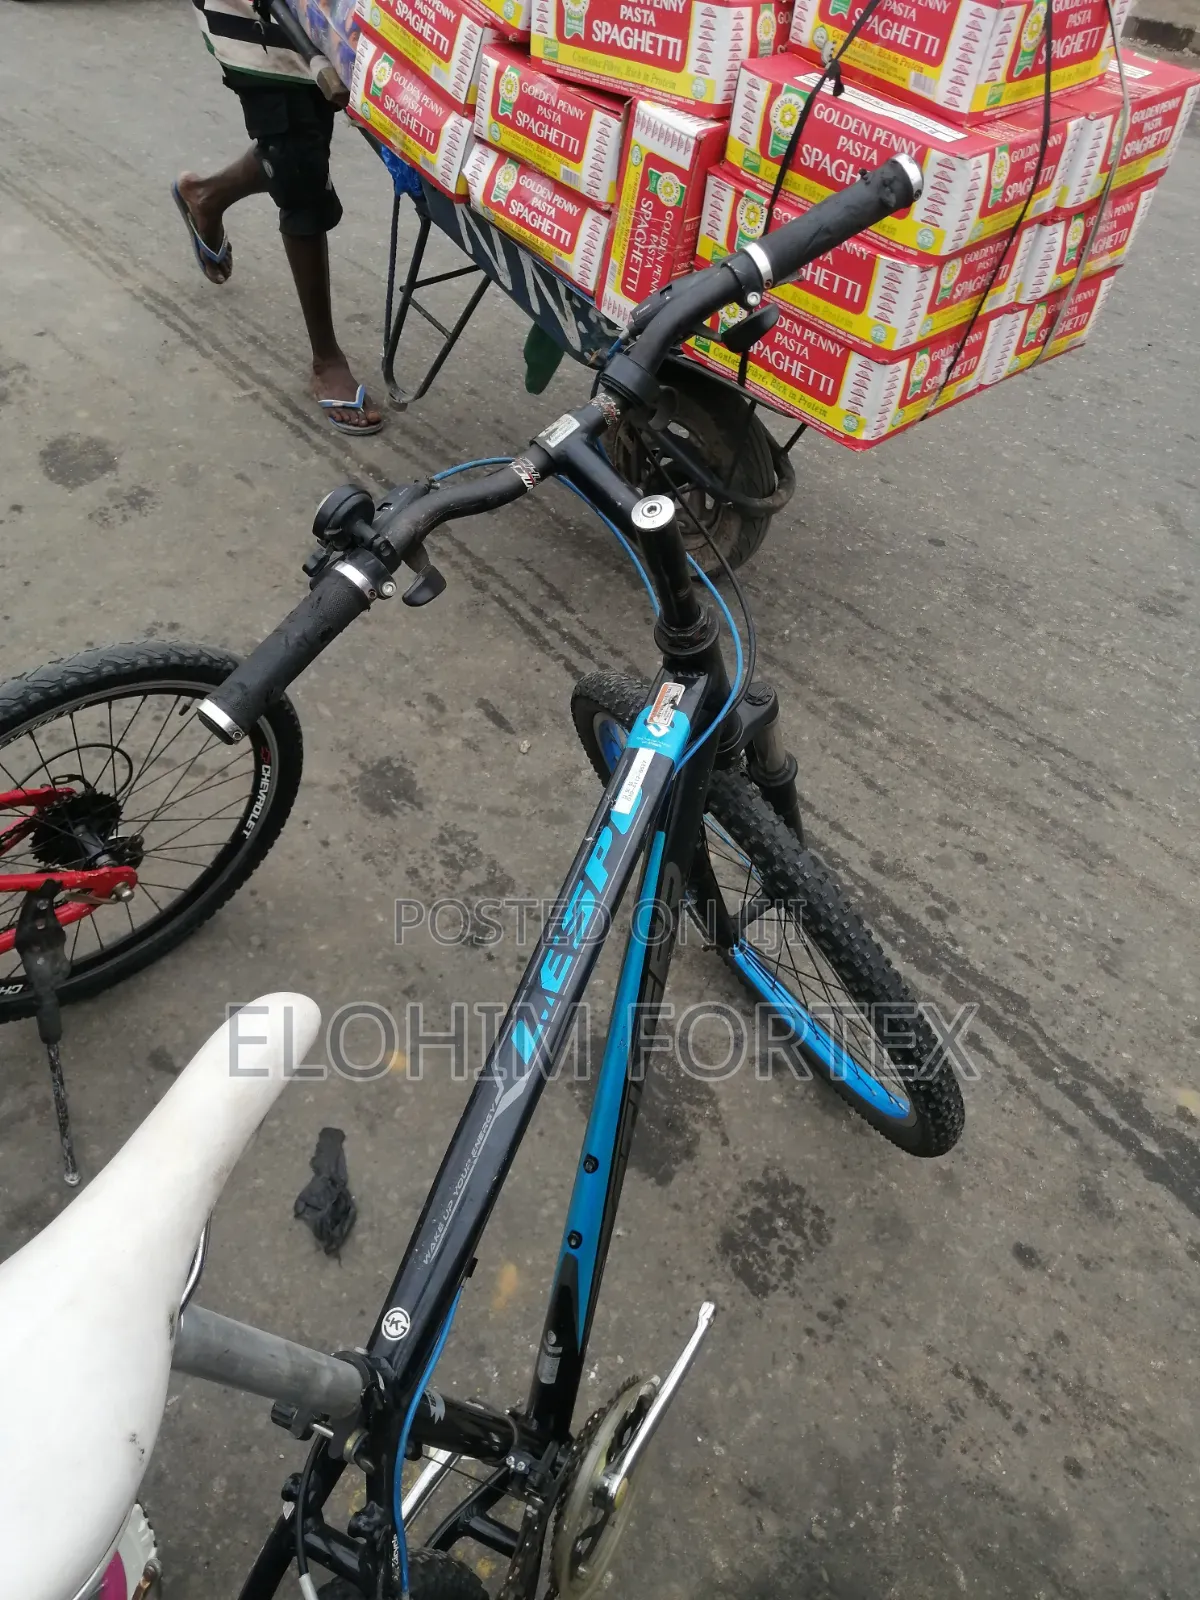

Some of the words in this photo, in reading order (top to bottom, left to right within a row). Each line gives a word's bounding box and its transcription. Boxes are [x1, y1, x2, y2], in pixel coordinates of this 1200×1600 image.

[395, 0, 449, 55] SPAGHETTI
[620, 5, 656, 28] PASTA
[883, 0, 917, 22] PASTA
[1066, 9, 1092, 28] PASTA
[592, 20, 682, 62] SPAGHETTI
[852, 8, 941, 57] SAGHETTI
[1038, 27, 1104, 64] SPAGHETT
[384, 94, 435, 146] SPAGHETTI
[421, 94, 445, 117] PENNY
[521, 82, 555, 108] GOLDEN
[557, 99, 587, 121] PENNY
[536, 104, 562, 125] PASTA
[515, 110, 580, 155] SPAGHETTI
[813, 102, 872, 140] GOLDEN
[872, 128, 922, 157] PENNY
[836, 135, 878, 165] PASTA
[1122, 126, 1173, 160] SPAGHETTI
[800, 143, 862, 186] SPAGH
[1005, 165, 1056, 203] SPAGTTI
[519, 175, 553, 202] GOLDEN
[552, 194, 580, 217] PENNY
[530, 196, 556, 219] PASTA
[509, 199, 571, 247] SPAGHETTI
[655, 210, 674, 264] GOLDEN
[625, 197, 654, 292] SPAGHETTI
[643, 232, 659, 269] PASTA
[649, 263, 663, 294] PENN
[800, 262, 862, 303] HETTI
[774, 331, 810, 360] PASTA
[776, 315, 803, 338] DEN
[803, 329, 845, 358] PENNY
[242, 764, 271, 839] CHEVROLET
[422, 1222, 445, 1265] WAKE
[443, 1198, 456, 1223] UP
[452, 1160, 473, 1197] YOUR
[470, 1107, 497, 1159] ENERGY
